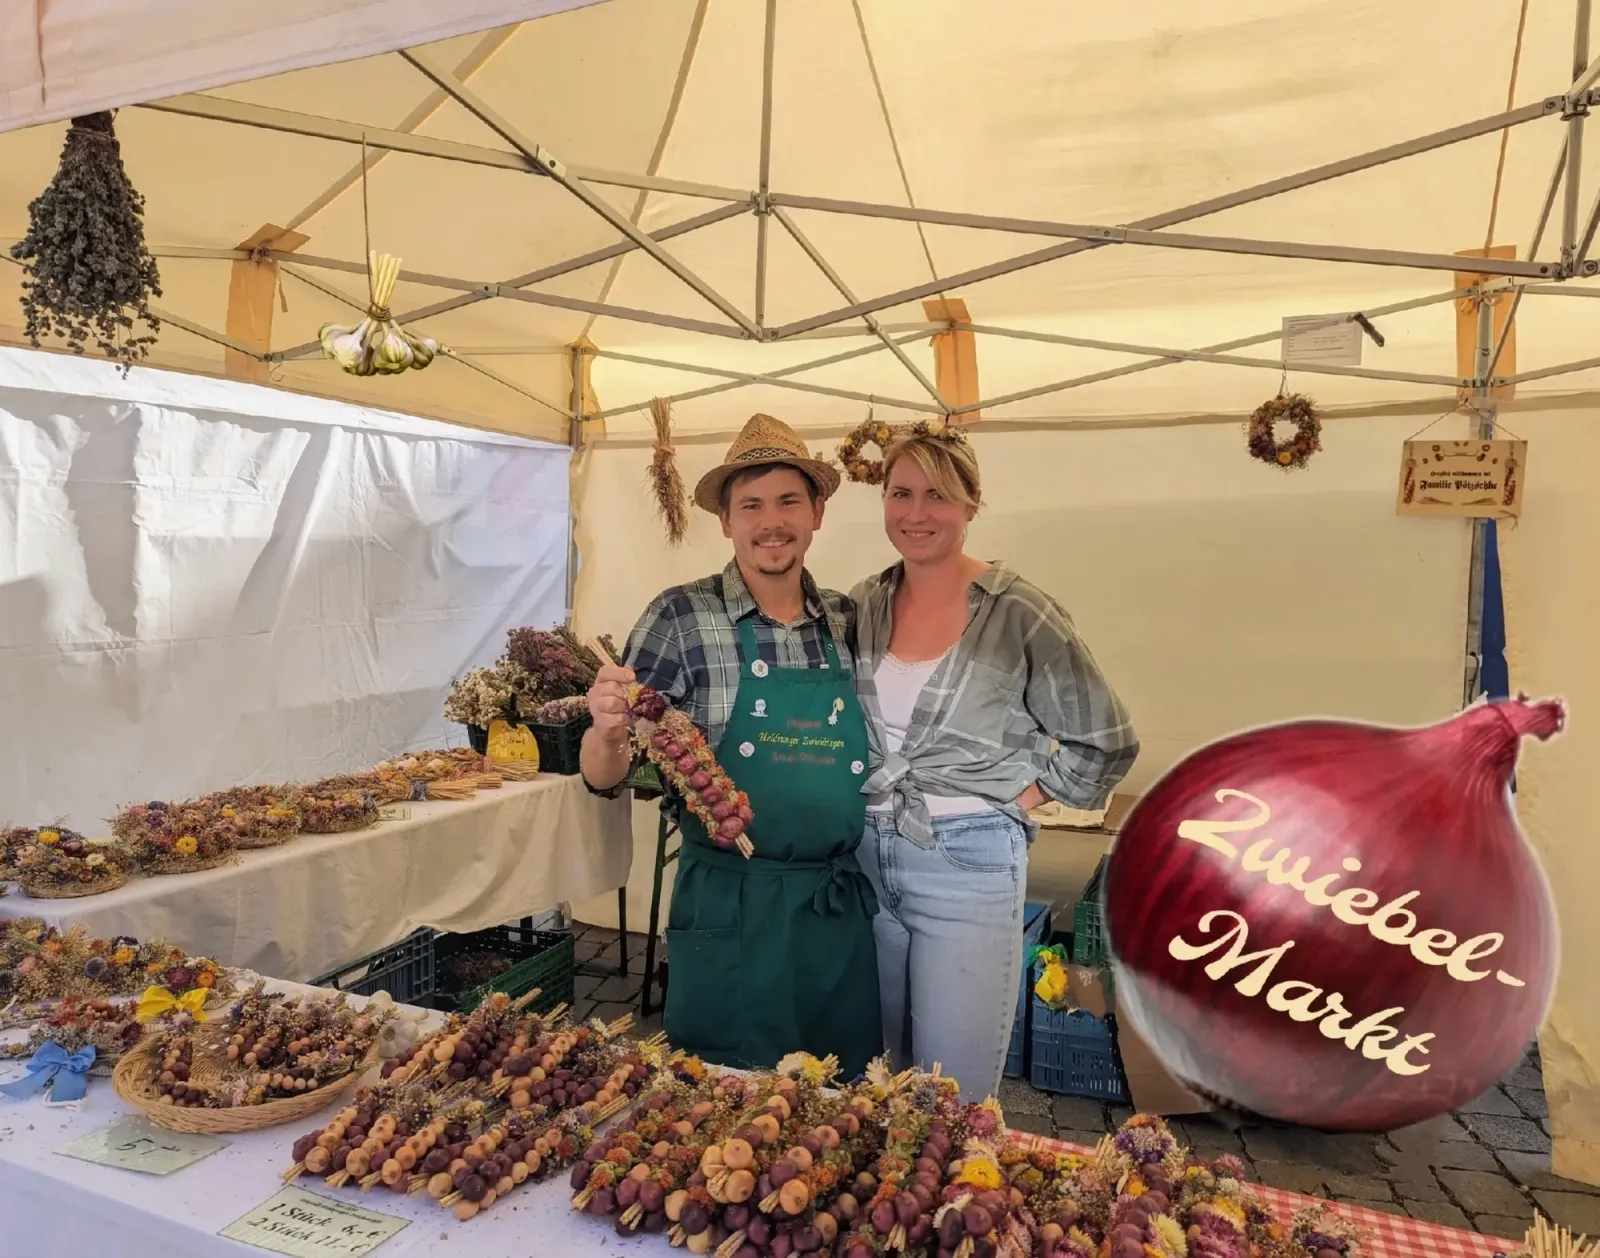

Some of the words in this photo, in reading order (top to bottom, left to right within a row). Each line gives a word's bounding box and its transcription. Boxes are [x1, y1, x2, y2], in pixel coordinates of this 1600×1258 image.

[1420, 480, 1452, 490] Familie
[267, 1202, 287, 1213] 1
[280, 1206, 332, 1227] Stück
[248, 1216, 269, 1228] 2
[263, 1220, 315, 1242] Stück
